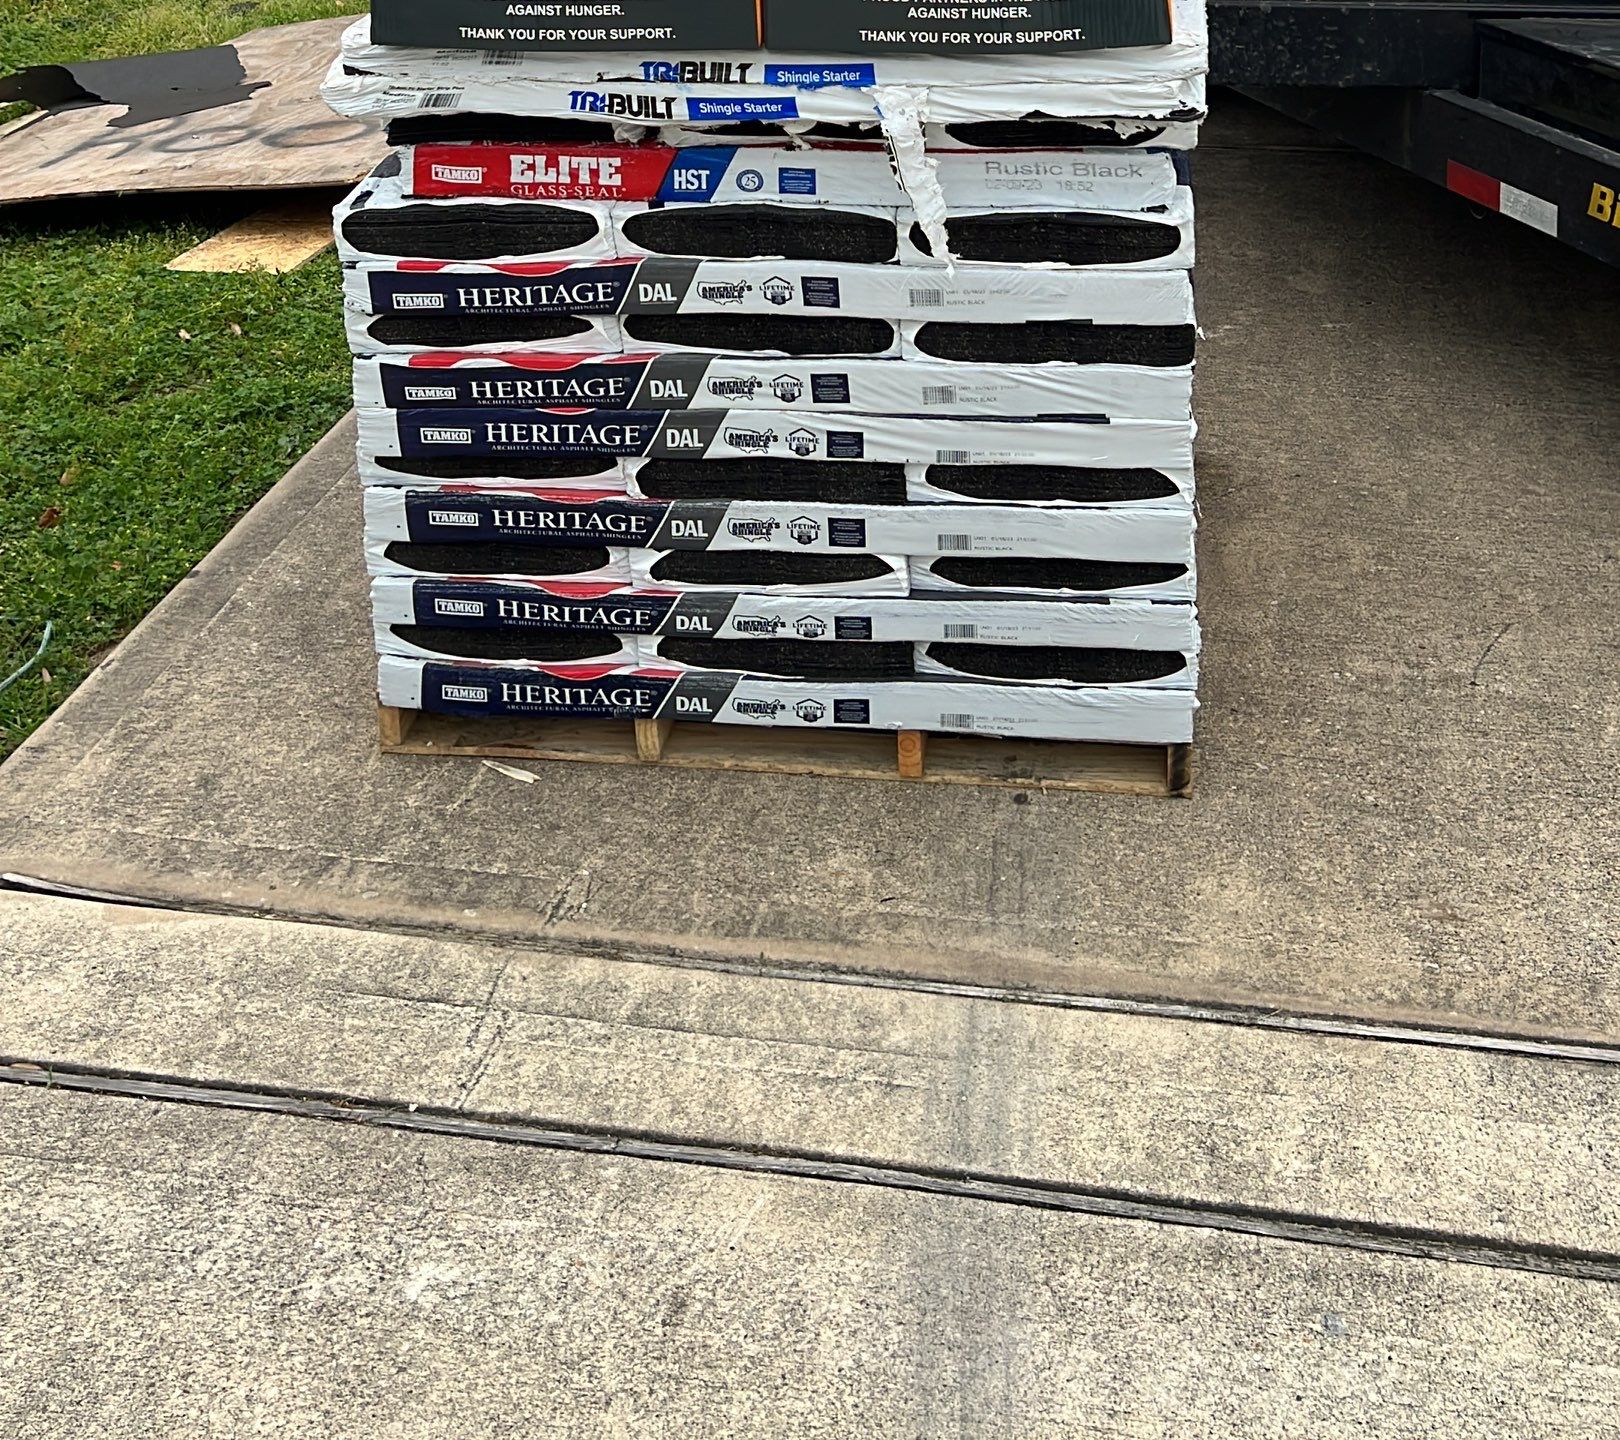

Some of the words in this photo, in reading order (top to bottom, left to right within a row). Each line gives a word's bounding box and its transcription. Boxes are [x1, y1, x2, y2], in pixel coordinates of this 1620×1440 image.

[506, 4, 562, 17] AGAINST
[565, 5, 625, 17] HUNGER.
[907, 7, 968, 19] AGAINST
[971, 7, 1032, 19] HUNGER.
[459, 27, 505, 40] THANK
[507, 29, 536, 41] YOU
[539, 29, 566, 41] FOR
[569, 28, 607, 41] YOUR
[609, 27, 676, 40] SUPPORT.
[859, 30, 907, 43] THANK
[909, 31, 940, 44] YOU
[942, 32, 971, 44] FOR
[973, 32, 1013, 44] YOUR
[1015, 28, 1086, 42] SUPPORT.
[777, 71, 820, 84] Shingle
[822, 70, 861, 82] Starter
[699, 102, 742, 114] Shingle
[744, 102, 782, 112] Starter
[435, 166, 479, 181] TAMKO
[509, 154, 622, 185] ELITE
[985, 161, 1063, 176] Rustic
[1072, 162, 1143, 178] Black
[673, 169, 710, 190] HST
[744, 176, 757, 187] 25
[510, 185, 624, 198] GLASS-SEAL
[456, 282, 615, 307] HERITAGE
[638, 283, 677, 302] DAL
[701, 285, 753, 293] AMERICA'S
[702, 291, 744, 299] SHINGLE
[396, 295, 440, 307] TAMKO
[469, 377, 626, 399] HERITAGE
[650, 380, 688, 398] DAL
[711, 380, 763, 389] AMERICA'S
[408, 389, 452, 398] TAMKO
[712, 387, 755, 395] SHINGLE
[424, 430, 468, 441] TAMKO
[484, 422, 641, 445] HERITAGE
[666, 428, 704, 448] DAL
[728, 432, 779, 443] AMERICA'S
[785, 436, 820, 444] LIFETIME
[432, 513, 475, 524] TAMKO
[491, 509, 648, 533] HERITAGE
[671, 520, 709, 538] DAL
[732, 521, 780, 529] AMERICA'S
[786, 523, 821, 531] LIFETIME
[499, 528, 562, 537] ARCHITECTURAL
[732, 528, 772, 536] SHINGLE
[439, 601, 480, 613] TAMKO
[496, 599, 652, 627] HERITAGE
[675, 615, 713, 631] DAL
[736, 620, 786, 628] AMERICA'S
[446, 688, 484, 700] TAMKO
[500, 683, 652, 707] HERITAGE
[675, 696, 713, 713] DAL
[736, 701, 786, 710] AMERICA'S
